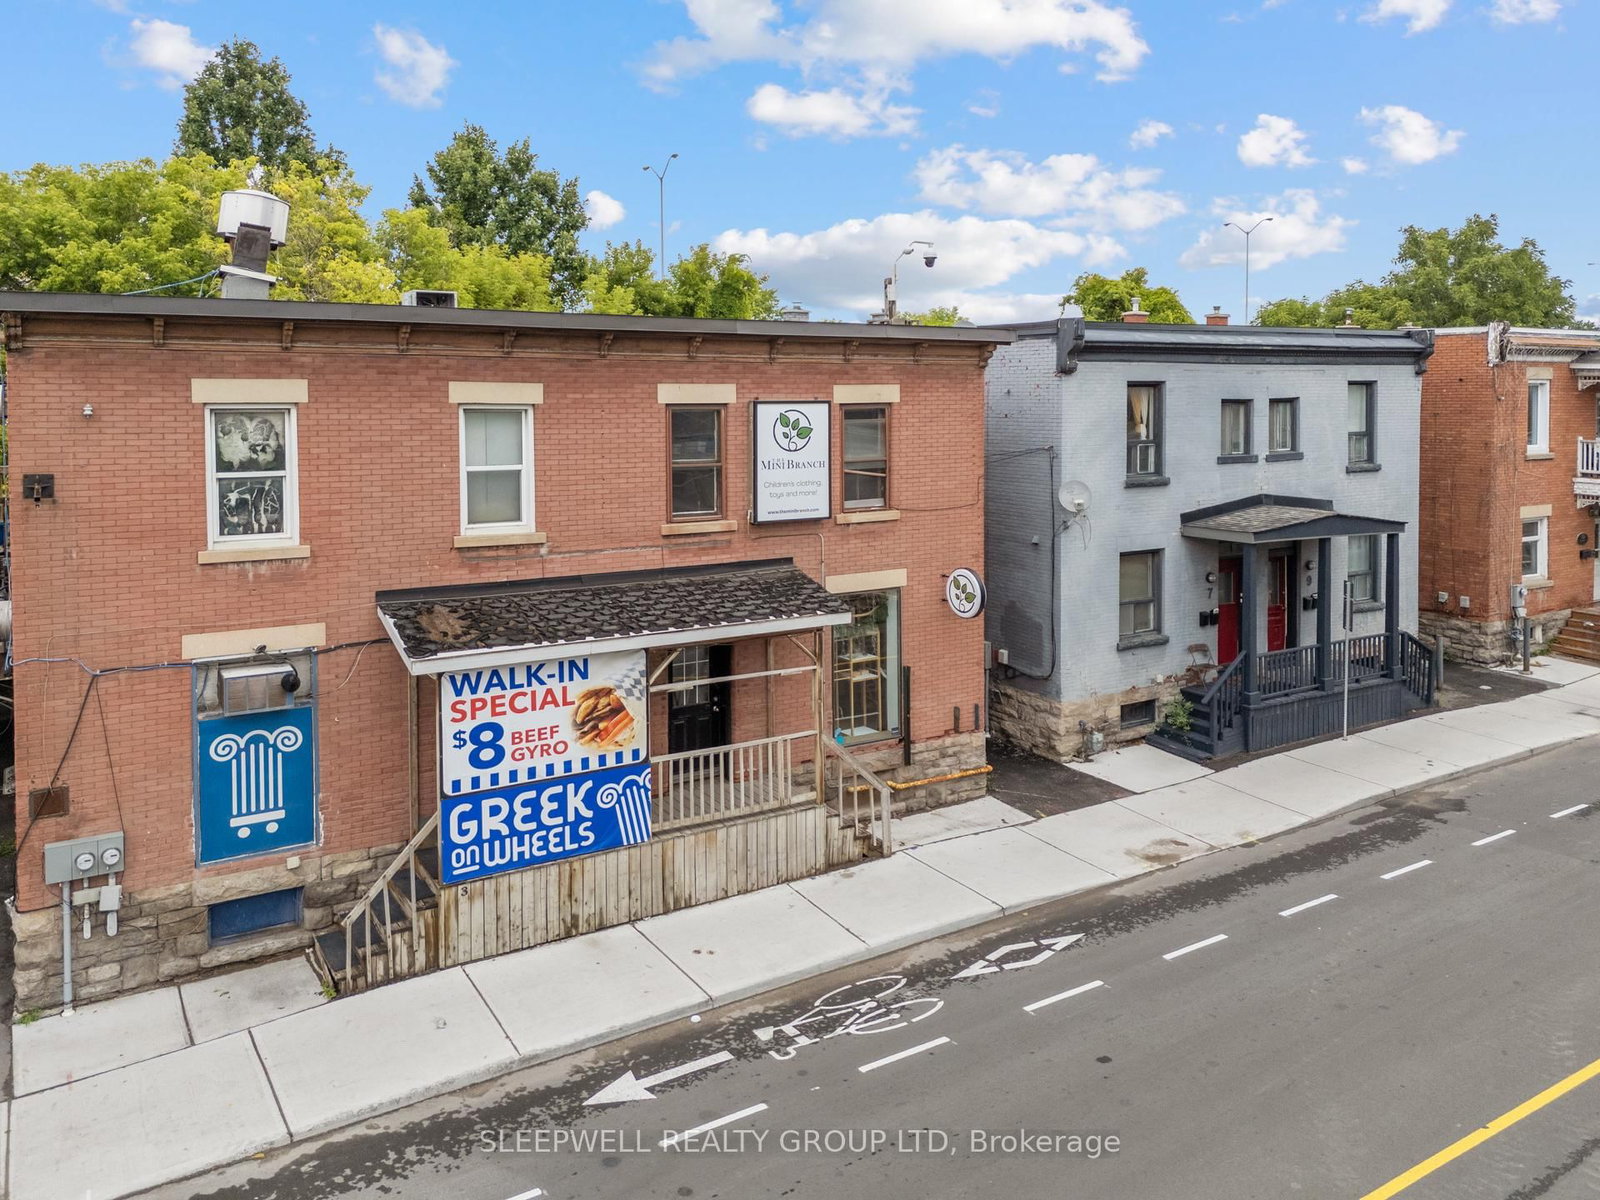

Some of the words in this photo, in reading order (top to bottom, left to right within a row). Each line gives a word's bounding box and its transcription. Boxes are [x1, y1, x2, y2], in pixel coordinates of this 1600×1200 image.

[787, 459, 825, 469] BRANCH
[769, 491, 785, 499] toys
[1306, 575, 1312, 586] 9
[1207, 587, 1214, 599] 7
[449, 658, 589, 697] WALK-IN
[450, 686, 576, 723] SPECIAL
[452, 721, 506, 770] $8
[511, 725, 560, 746] BEEF
[511, 740, 569, 762] GYRO
[449, 780, 594, 844] GREEK
[483, 821, 595, 867] WHEELS
[461, 886, 468, 896] 3
